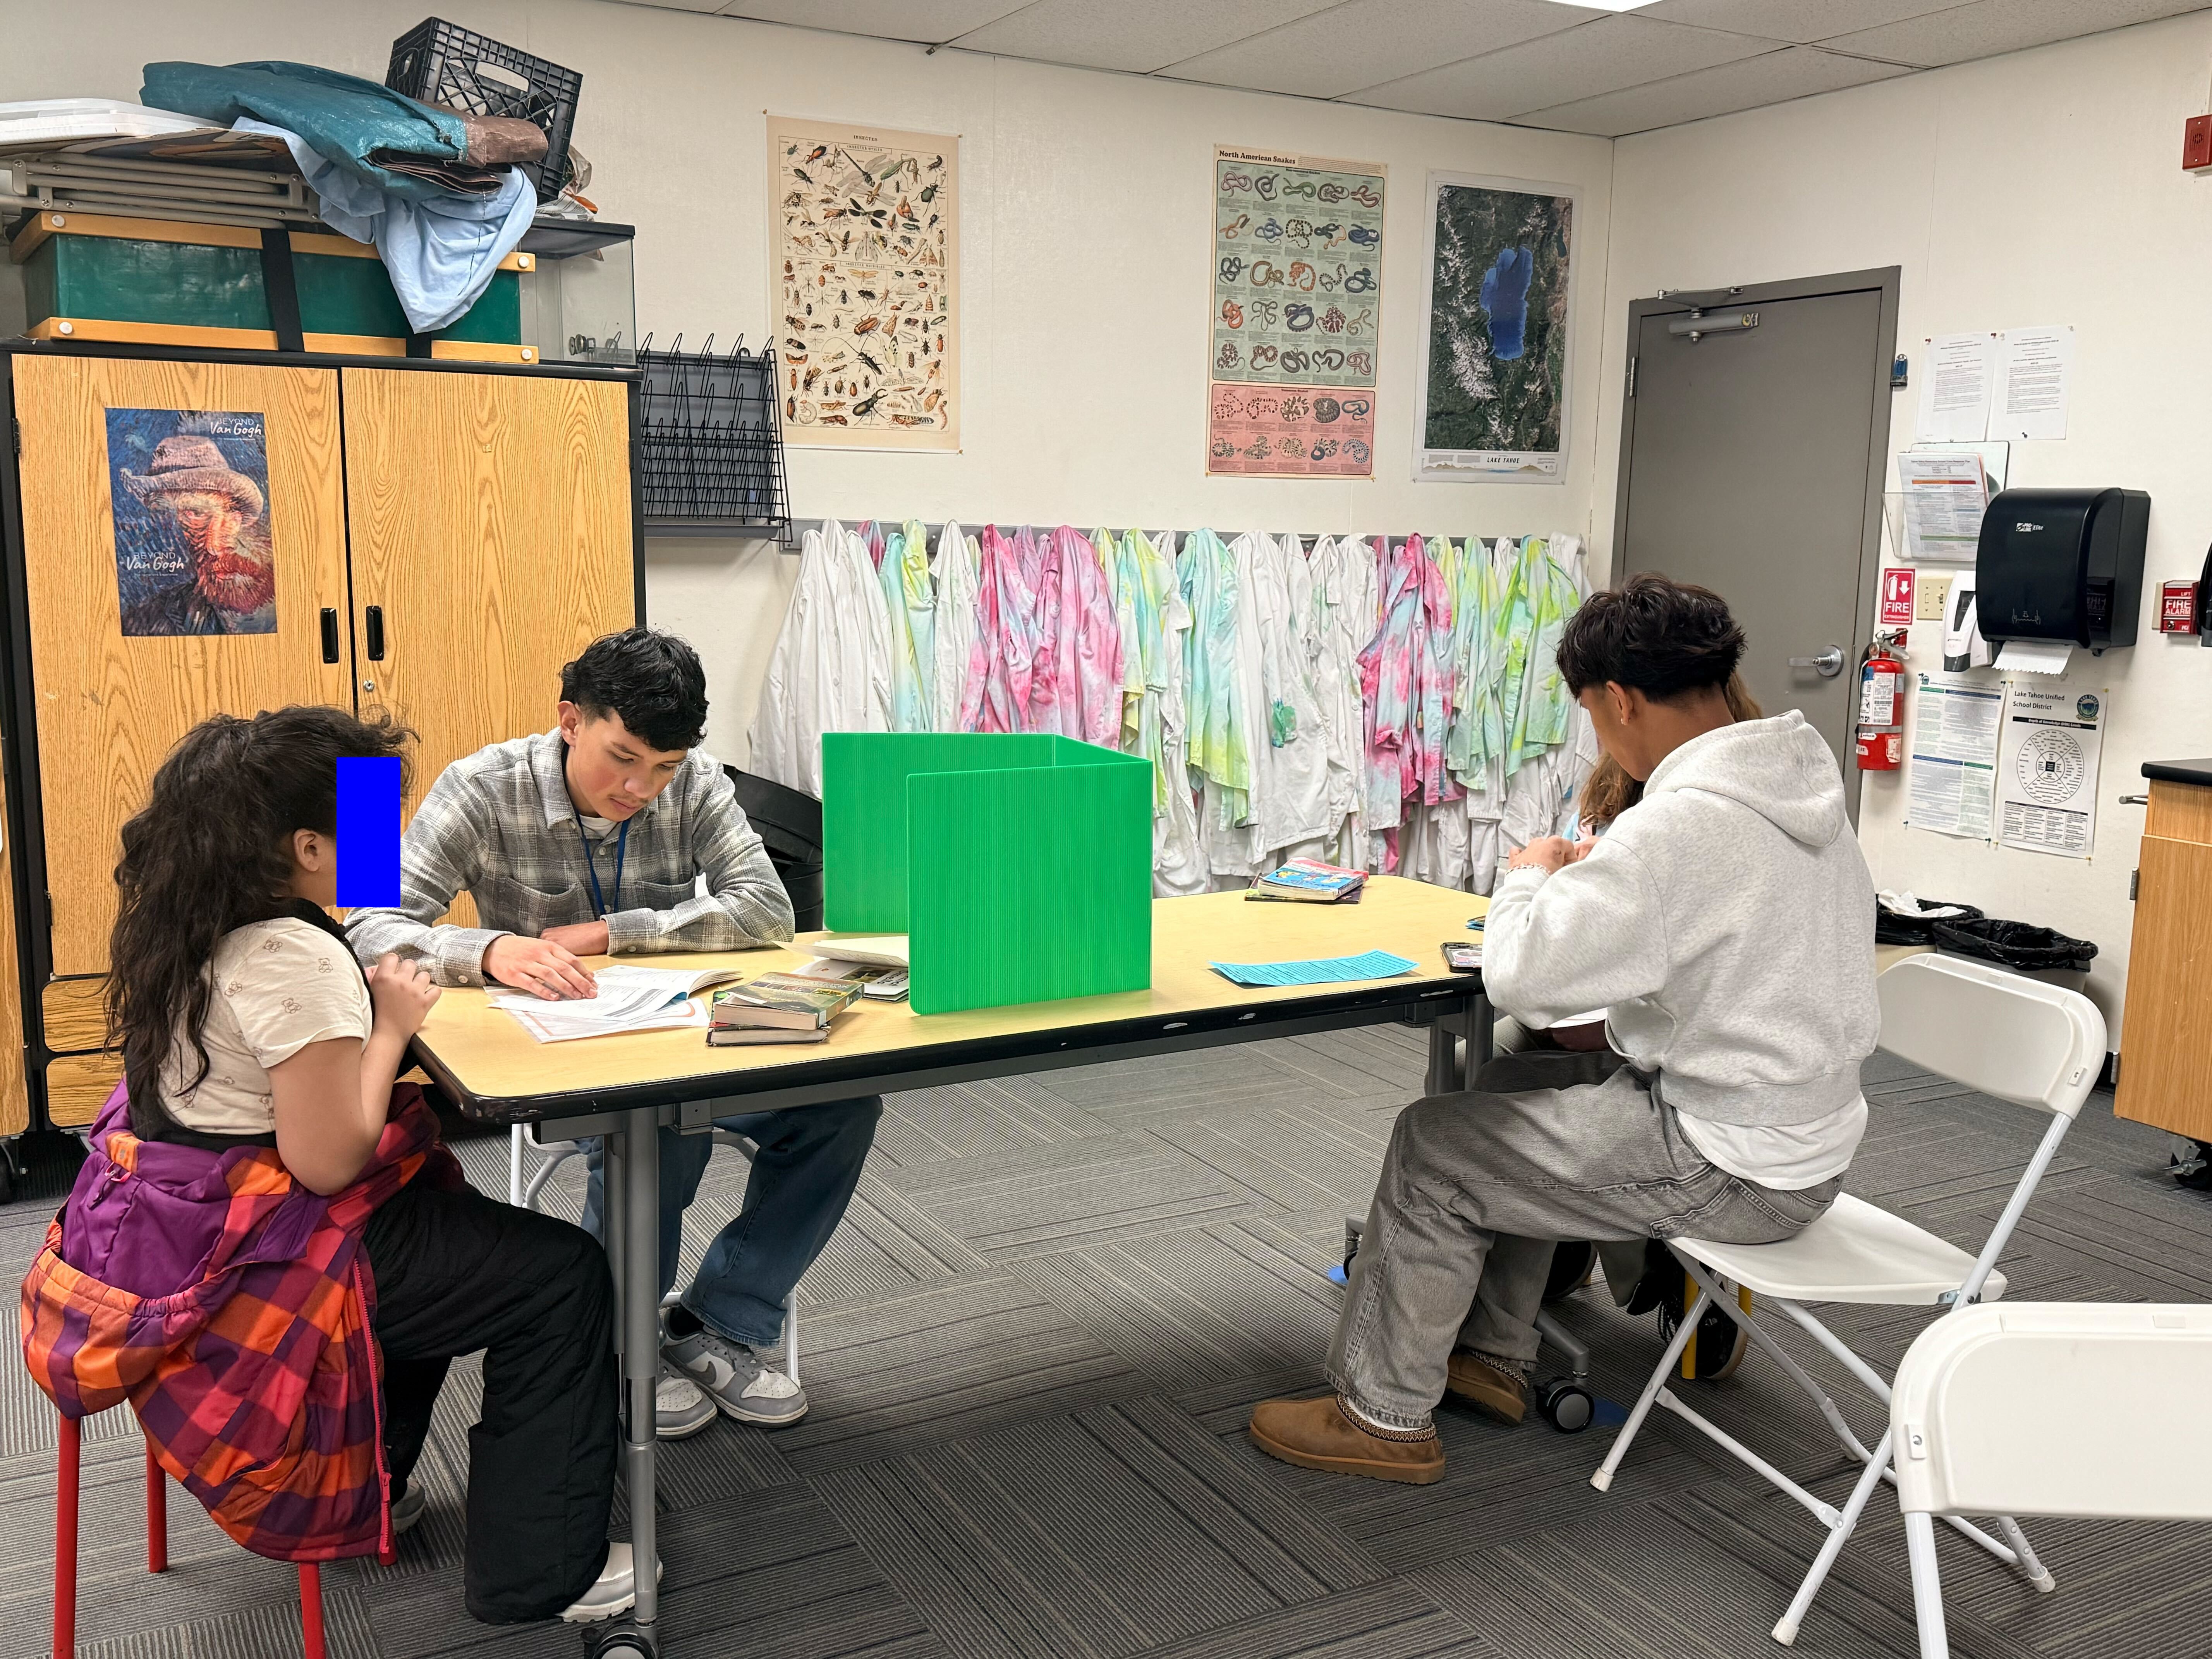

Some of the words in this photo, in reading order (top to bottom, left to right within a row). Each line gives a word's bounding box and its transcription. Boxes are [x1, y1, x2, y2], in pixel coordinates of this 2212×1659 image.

[1219, 150, 1239, 158] North
[1240, 153, 1272, 161] American
[1273, 156, 1296, 164] Snakes
[210, 421, 231, 434] Van
[233, 422, 262, 438] Gogh
[127, 556, 150, 570] Van
[153, 556, 184, 573] Gogh
[1885, 601, 1910, 613] FIRE
[2166, 599, 2191, 609] FIRE
